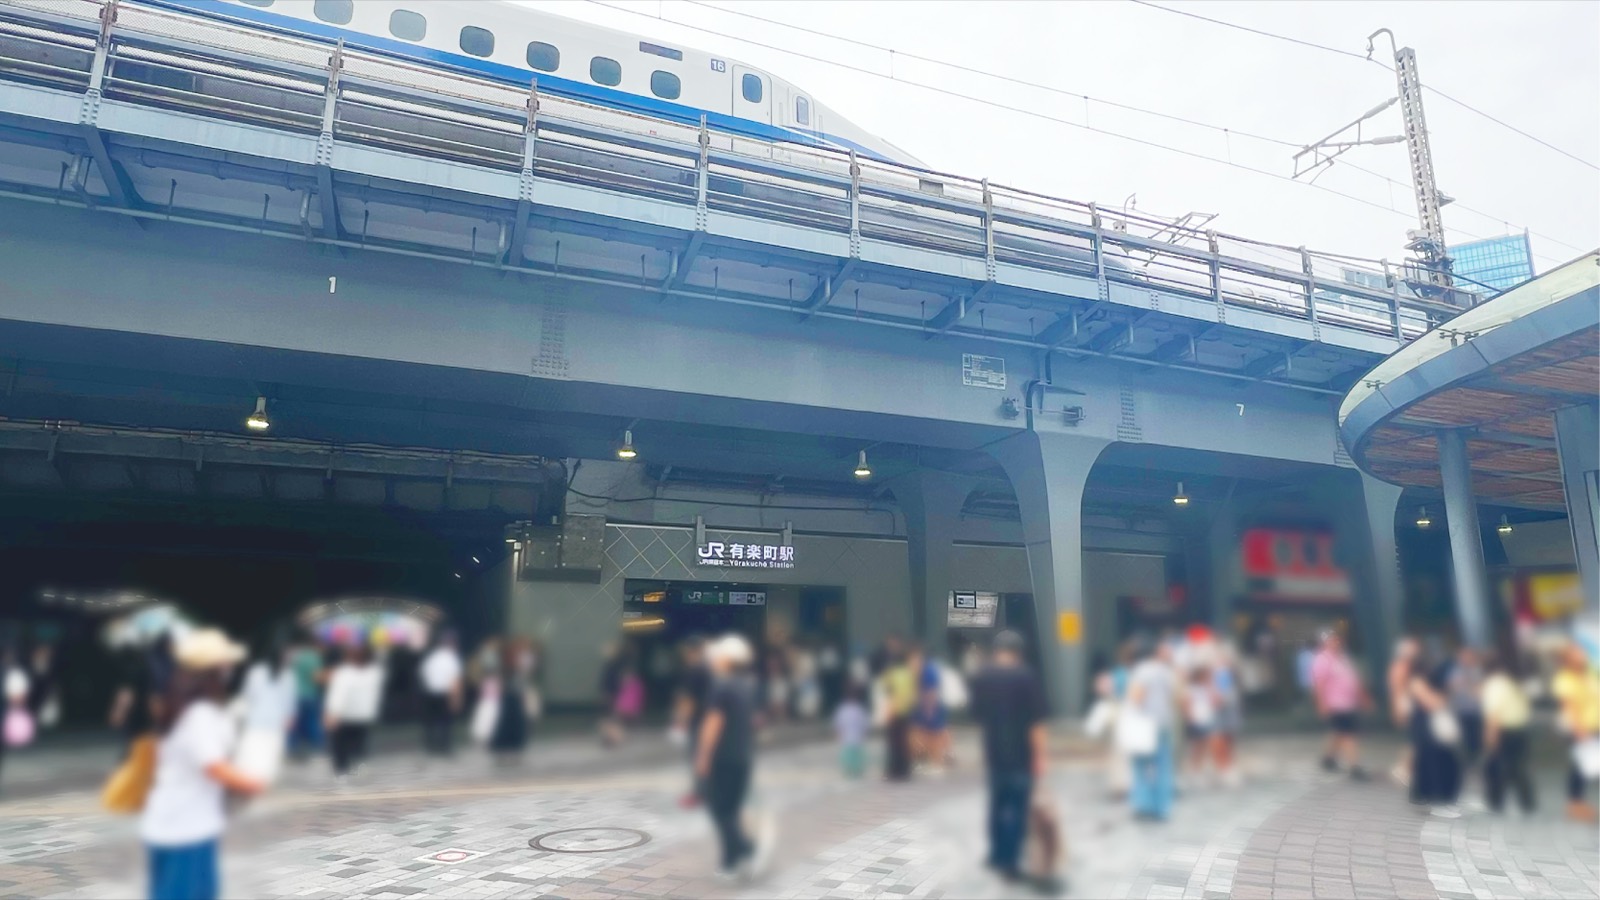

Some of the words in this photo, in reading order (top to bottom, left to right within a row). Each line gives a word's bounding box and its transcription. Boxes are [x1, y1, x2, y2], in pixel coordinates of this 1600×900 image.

[712, 61, 724, 72] 16
[329, 276, 336, 293] 1
[1236, 403, 1244, 416] 7
[698, 542, 725, 558] JR
[729, 543, 794, 561] 有楽町駅
[769, 561, 794, 569] Station
[688, 591, 702, 600] JR
